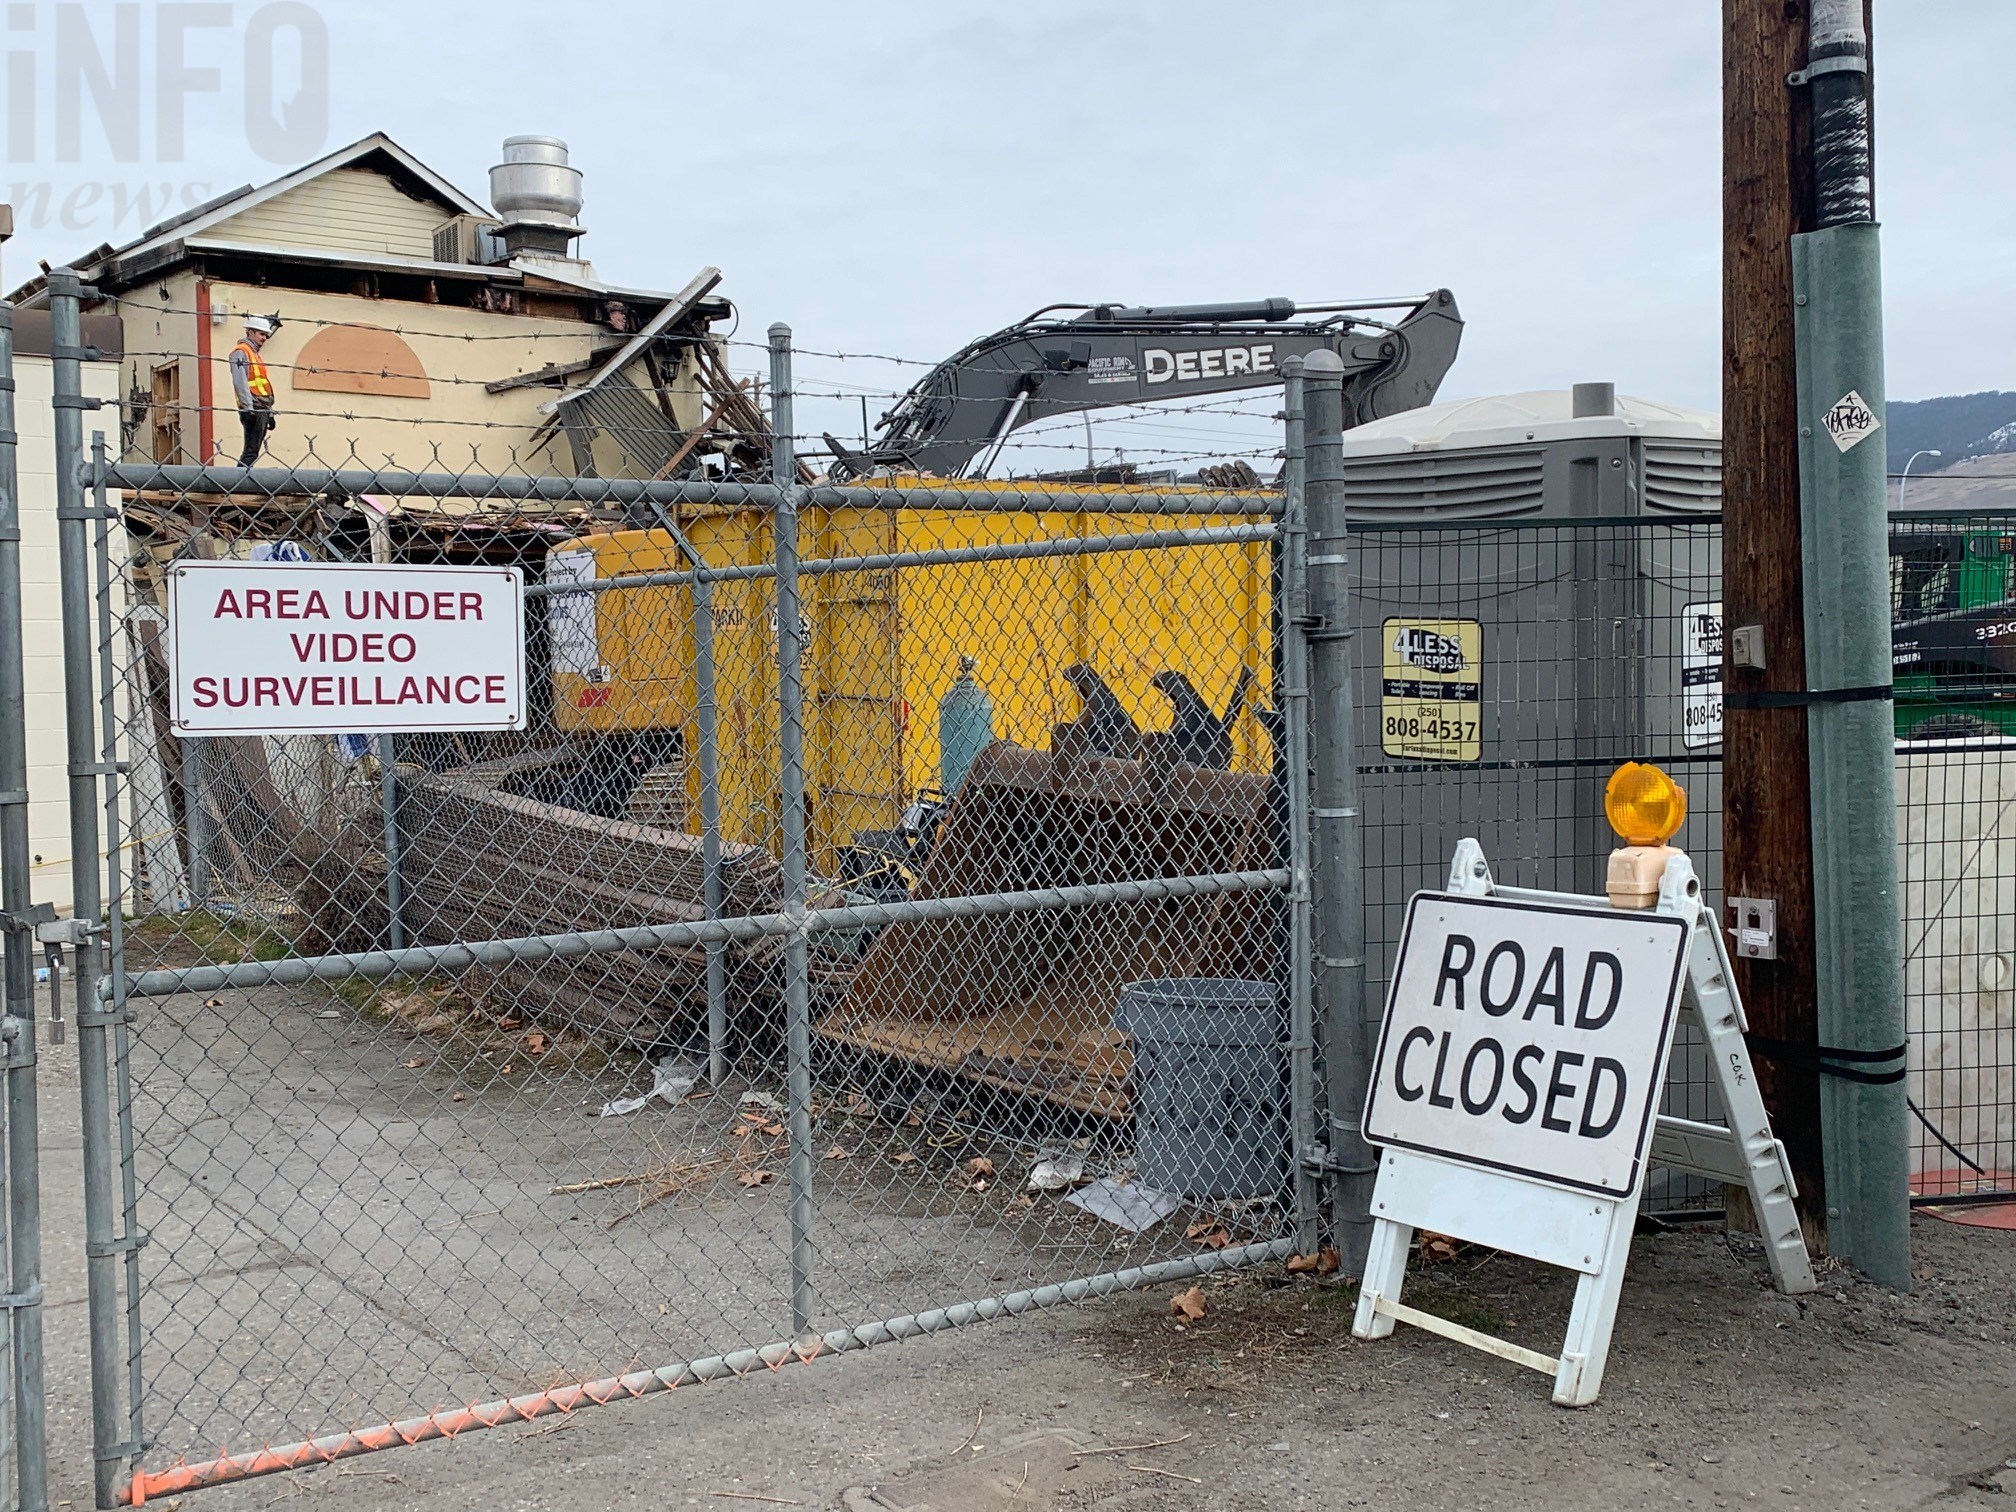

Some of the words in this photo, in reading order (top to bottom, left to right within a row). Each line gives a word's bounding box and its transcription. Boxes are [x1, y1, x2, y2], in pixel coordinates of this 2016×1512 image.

[1144, 344, 1275, 383] DEERE
[214, 589, 330, 619] AREA
[345, 590, 483, 621] UNDER
[290, 633, 416, 663] VIDEO
[1414, 655, 1470, 670] DISPOSAL
[193, 675, 506, 708] SURVEILLANCE
[1386, 716, 1476, 741] 808-4537
[1418, 707, 1441, 718] (250)
[1433, 934, 1623, 1031] ROAD
[1395, 1025, 1628, 1139] CLOSED
